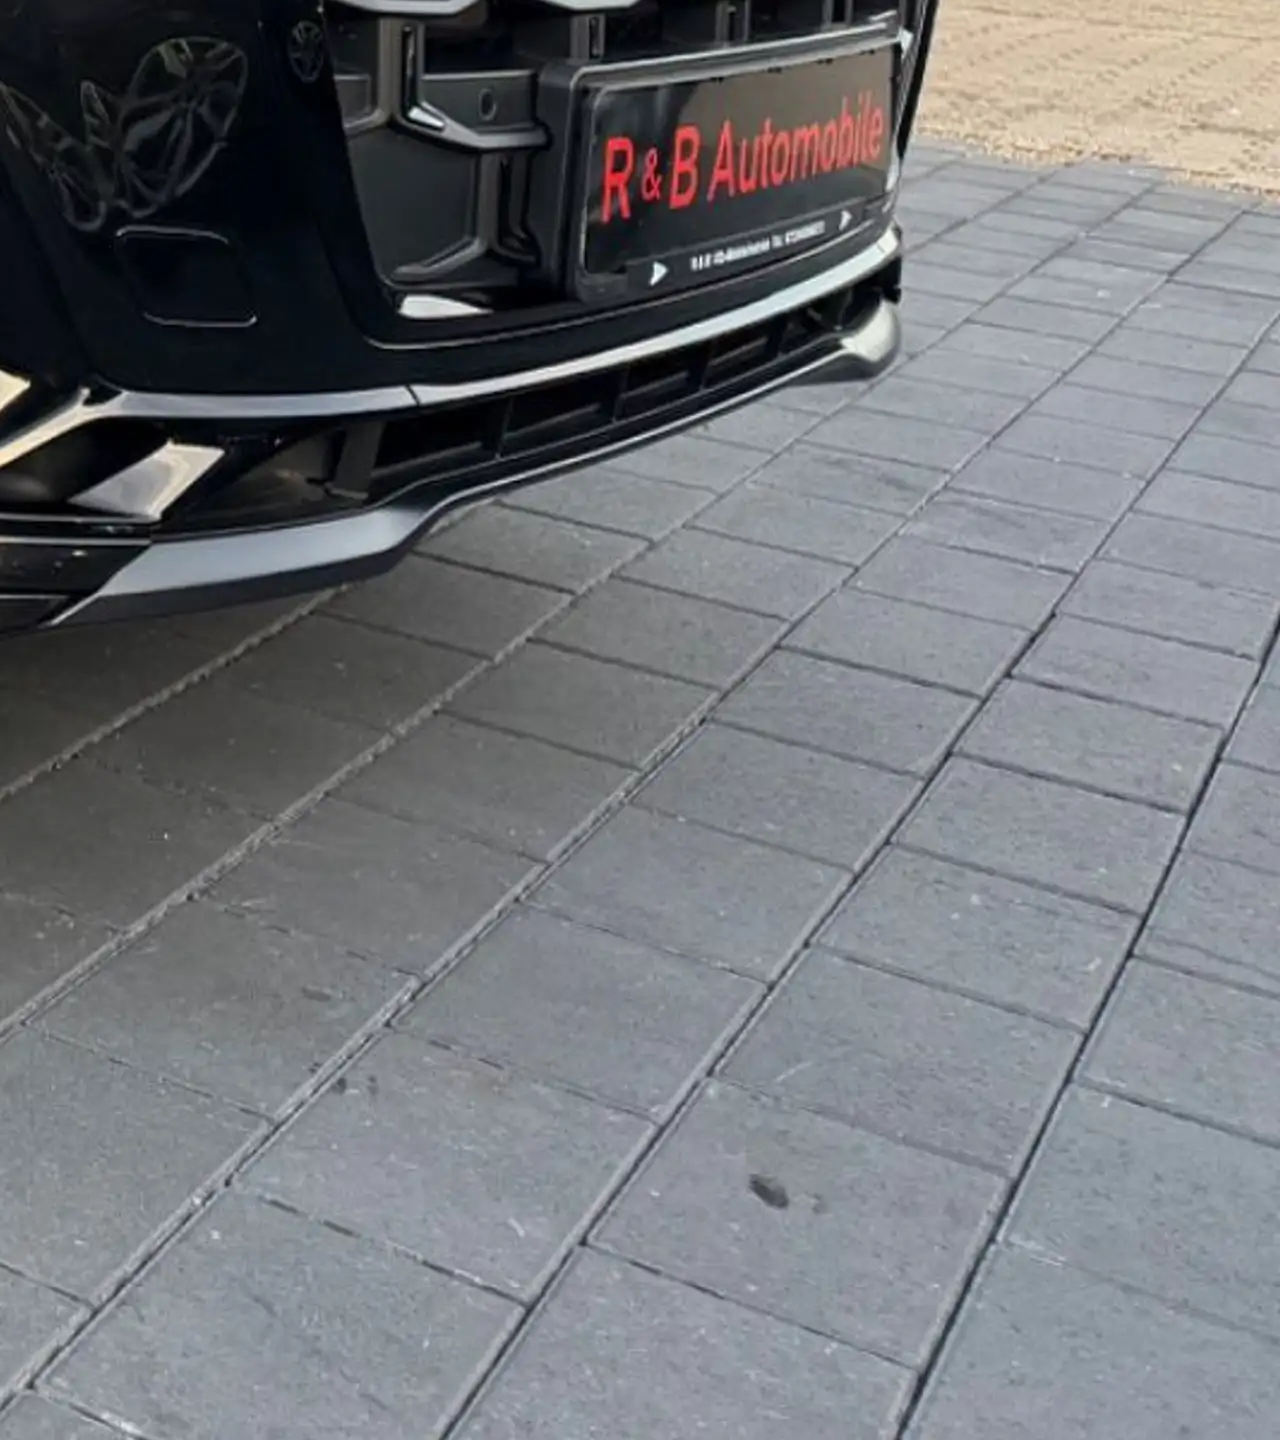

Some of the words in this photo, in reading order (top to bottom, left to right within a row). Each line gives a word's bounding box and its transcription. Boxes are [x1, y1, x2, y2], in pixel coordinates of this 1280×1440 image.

[602, 137, 634, 224] R
[642, 147, 662, 201] &
[669, 125, 700, 209] B
[706, 91, 883, 203] Automobile
